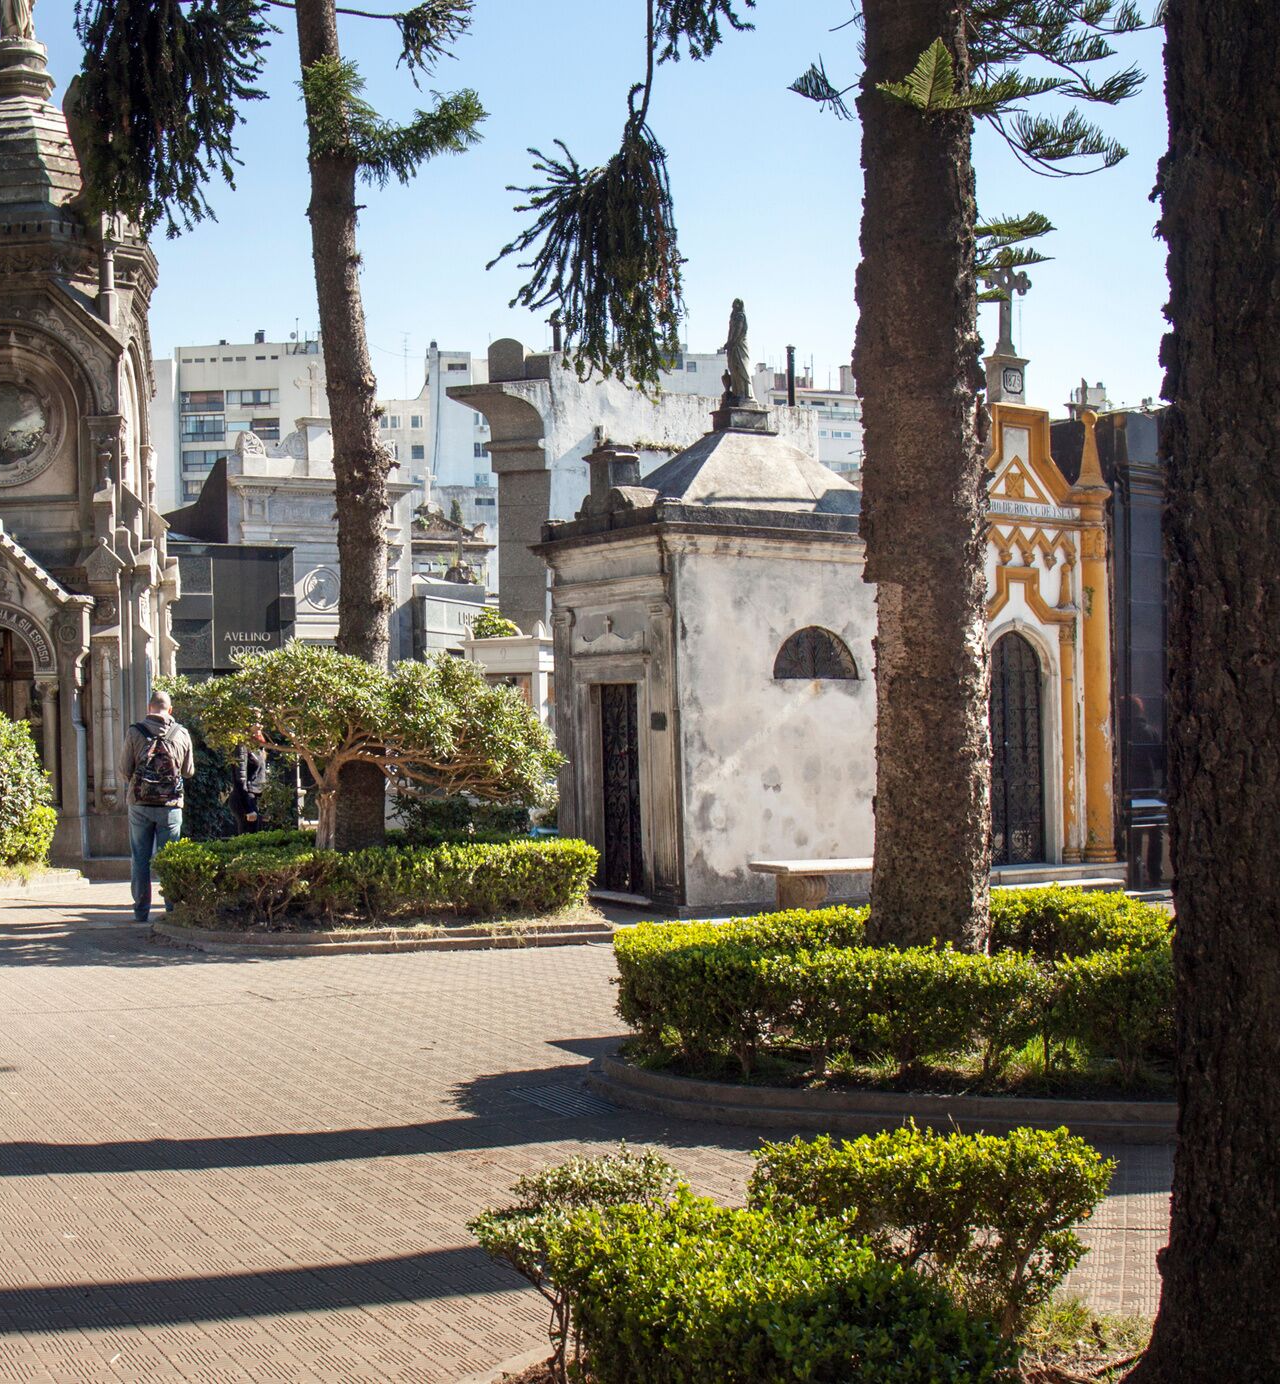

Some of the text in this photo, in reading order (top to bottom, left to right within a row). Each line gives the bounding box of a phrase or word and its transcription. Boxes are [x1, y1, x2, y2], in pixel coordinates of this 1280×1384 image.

[9, 613, 17, 624] A
[18, 618, 32, 634] SU
[28, 630, 50, 663] ESPOSO
[223, 631, 271, 642] AVELINO
[230, 645, 266, 656] PORTO
